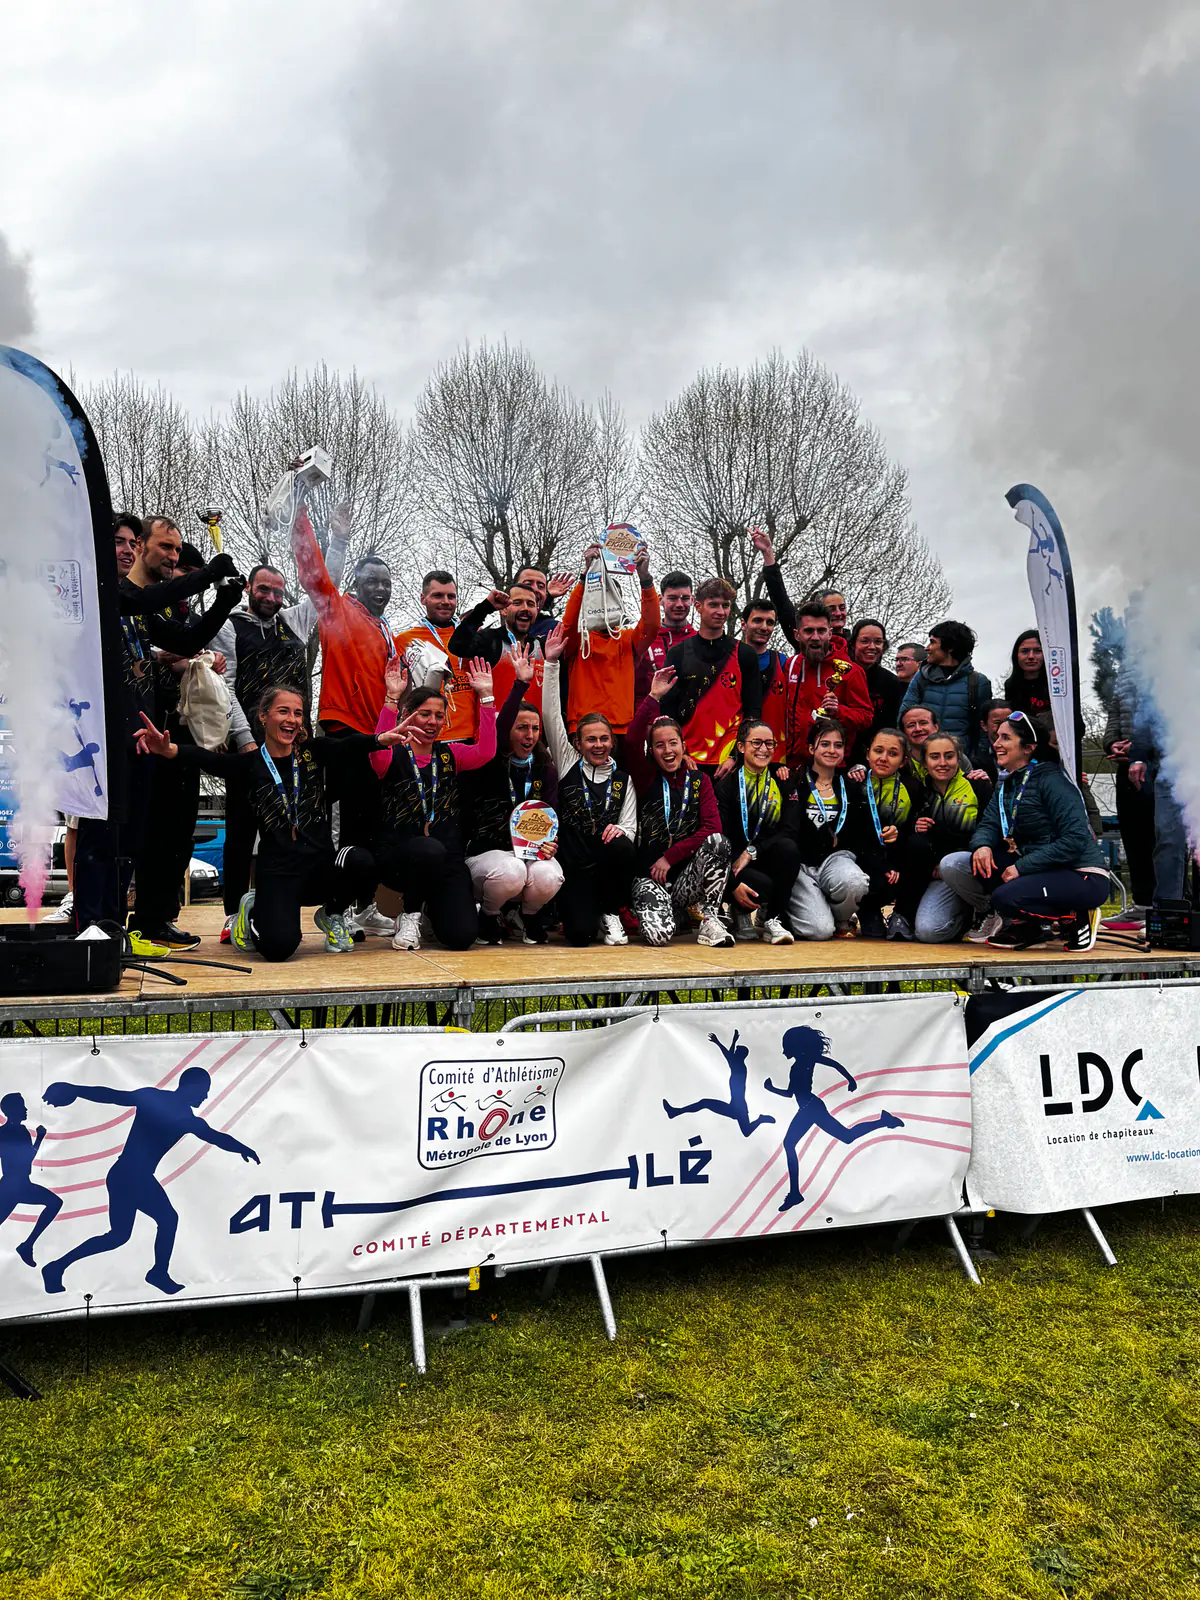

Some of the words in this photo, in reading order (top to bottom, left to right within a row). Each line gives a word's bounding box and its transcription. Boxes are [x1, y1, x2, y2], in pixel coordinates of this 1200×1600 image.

[429, 1068, 474, 1084] Comité
[483, 1065, 559, 1084] d'Athlétisme
[1040, 1048, 1144, 1116] LDC
[426, 1140, 491, 1162] Métropole
[495, 1135, 511, 1146] de
[516, 1132, 548, 1146] Lyon
[1047, 1132, 1086, 1145] Location
[1089, 1130, 1099, 1141] de
[1102, 1127, 1154, 1141] chapiteaux
[352, 1230, 432, 1256] COMITÉ
[441, 1210, 611, 1244] DÉPARTEMENTAL
